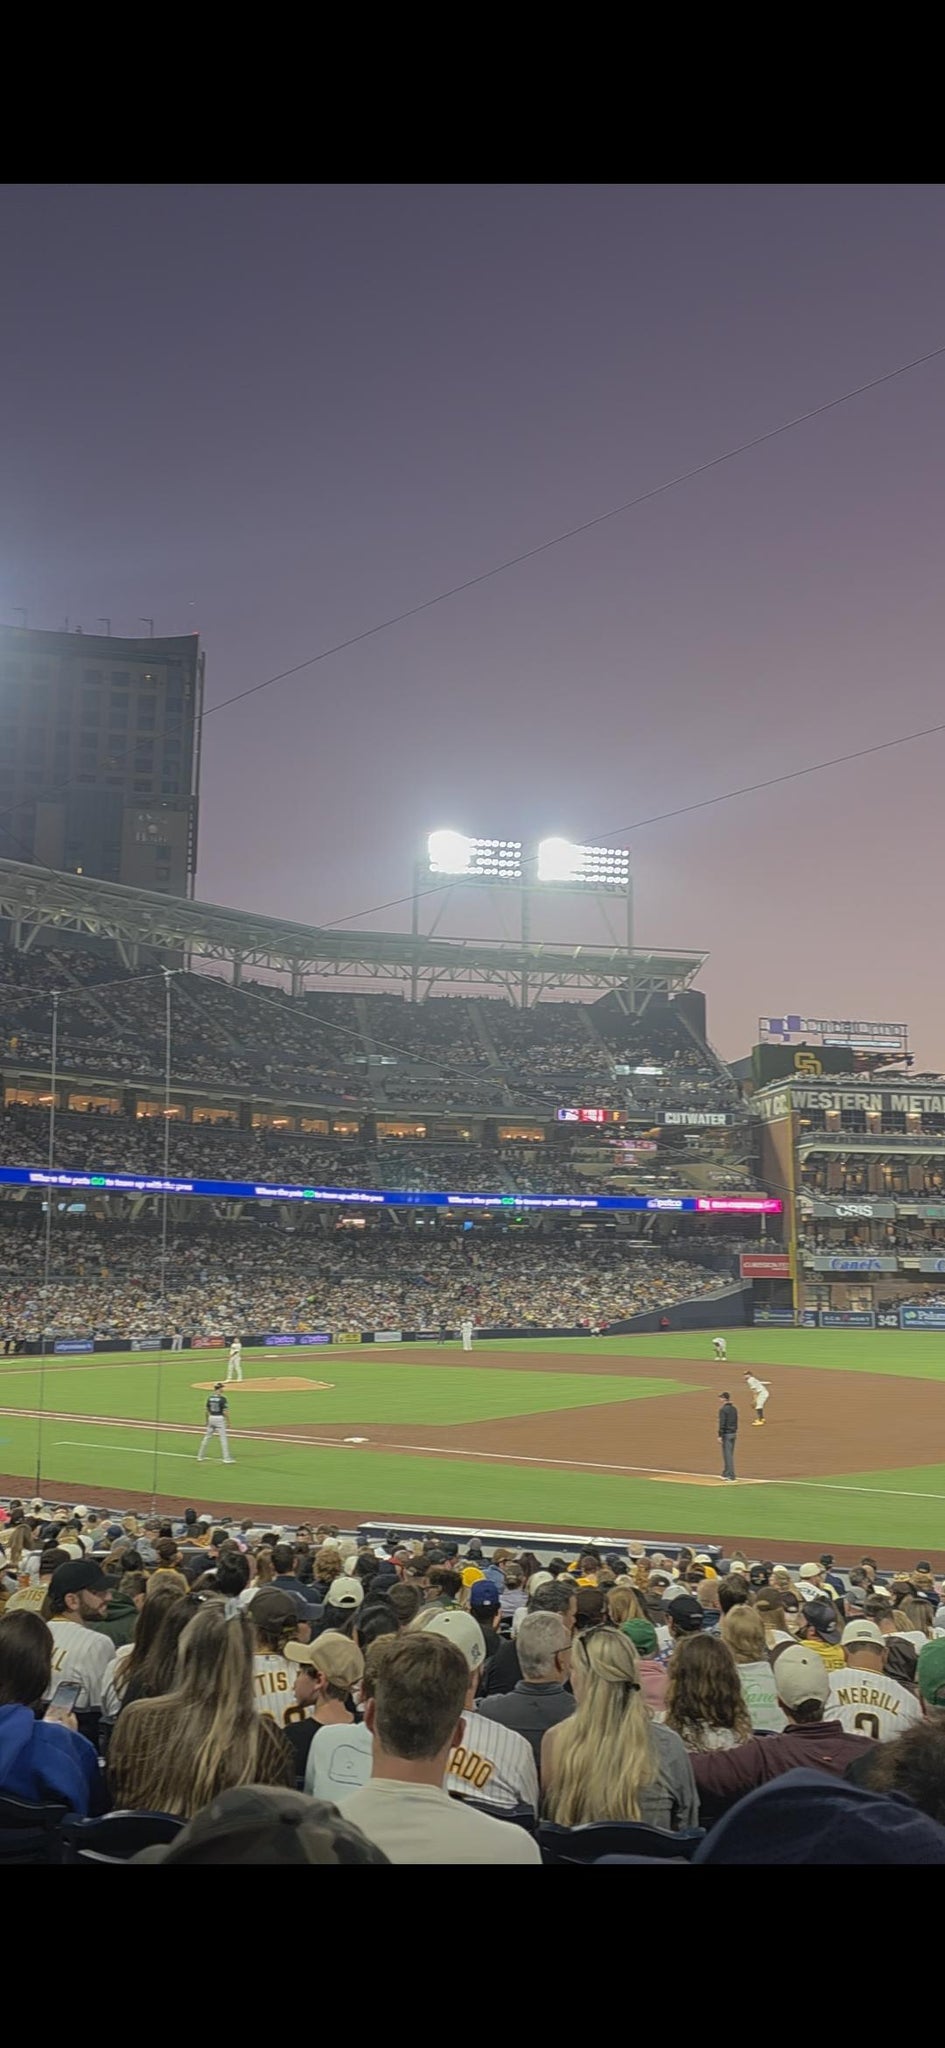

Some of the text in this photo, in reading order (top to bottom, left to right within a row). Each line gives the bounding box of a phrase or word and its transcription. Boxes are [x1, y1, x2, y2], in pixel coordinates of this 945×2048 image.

[791, 1090, 882, 1111] WESTERN
[664, 1112, 727, 1125] CUTWATER
[836, 1686, 901, 1717] MERRILL
